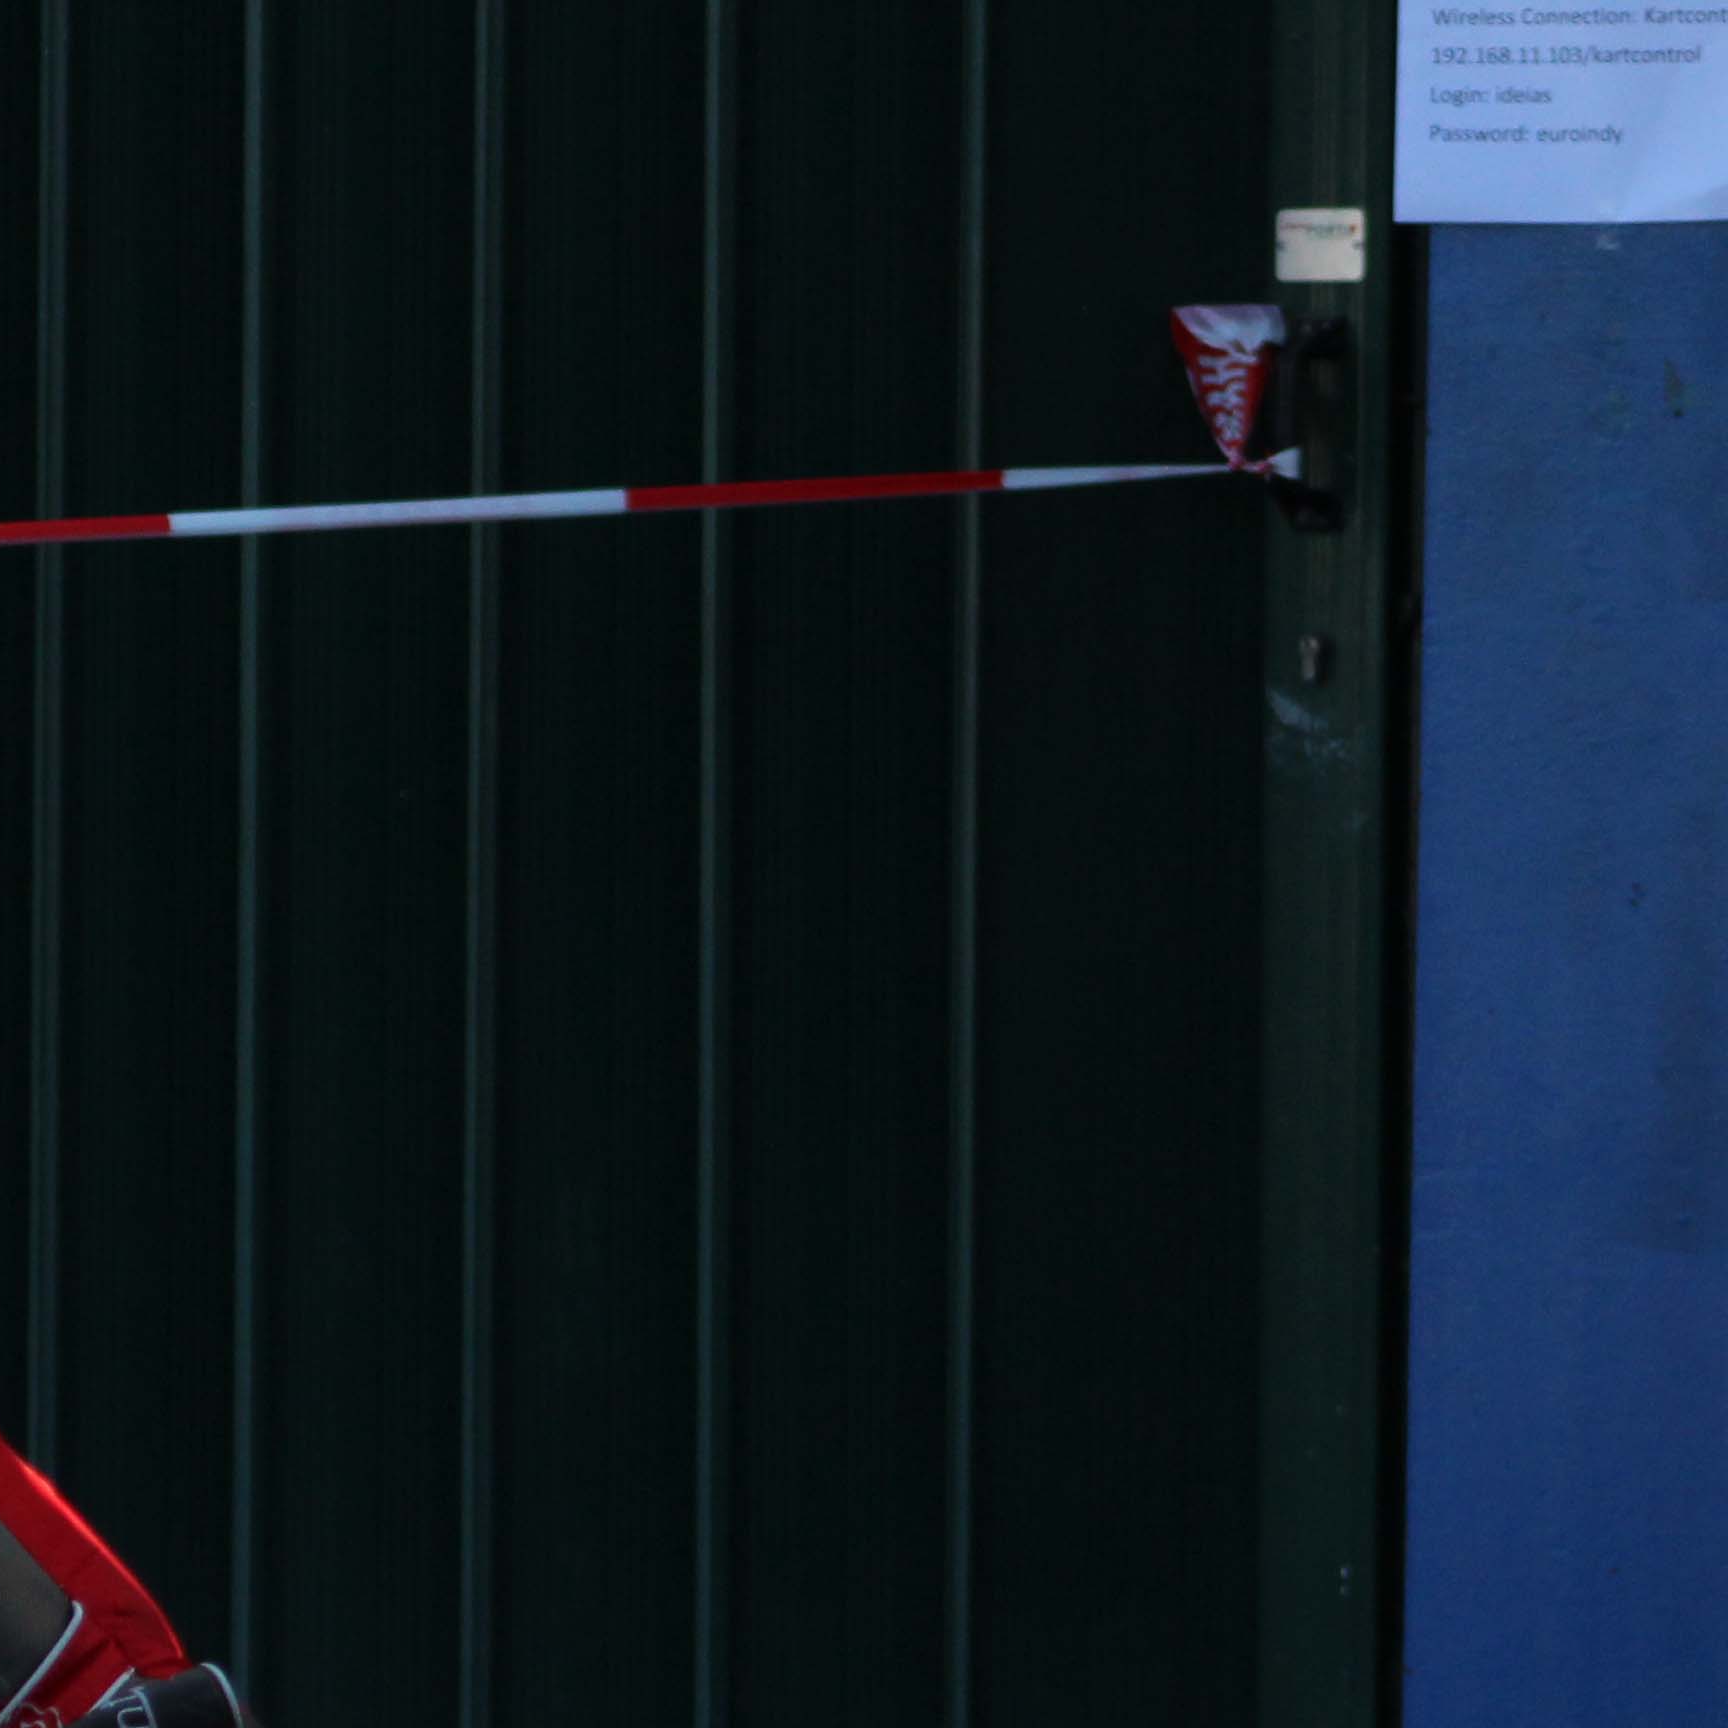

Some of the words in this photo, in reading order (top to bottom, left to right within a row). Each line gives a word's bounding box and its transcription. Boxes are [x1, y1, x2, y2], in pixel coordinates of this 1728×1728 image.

[1432, 8, 1515, 25] Wireless
[1521, 8, 1636, 25] Connection:
[1429, 87, 1488, 107] Login:
[1429, 125, 1529, 143] Password:
[1536, 125, 1622, 145] euroindy
